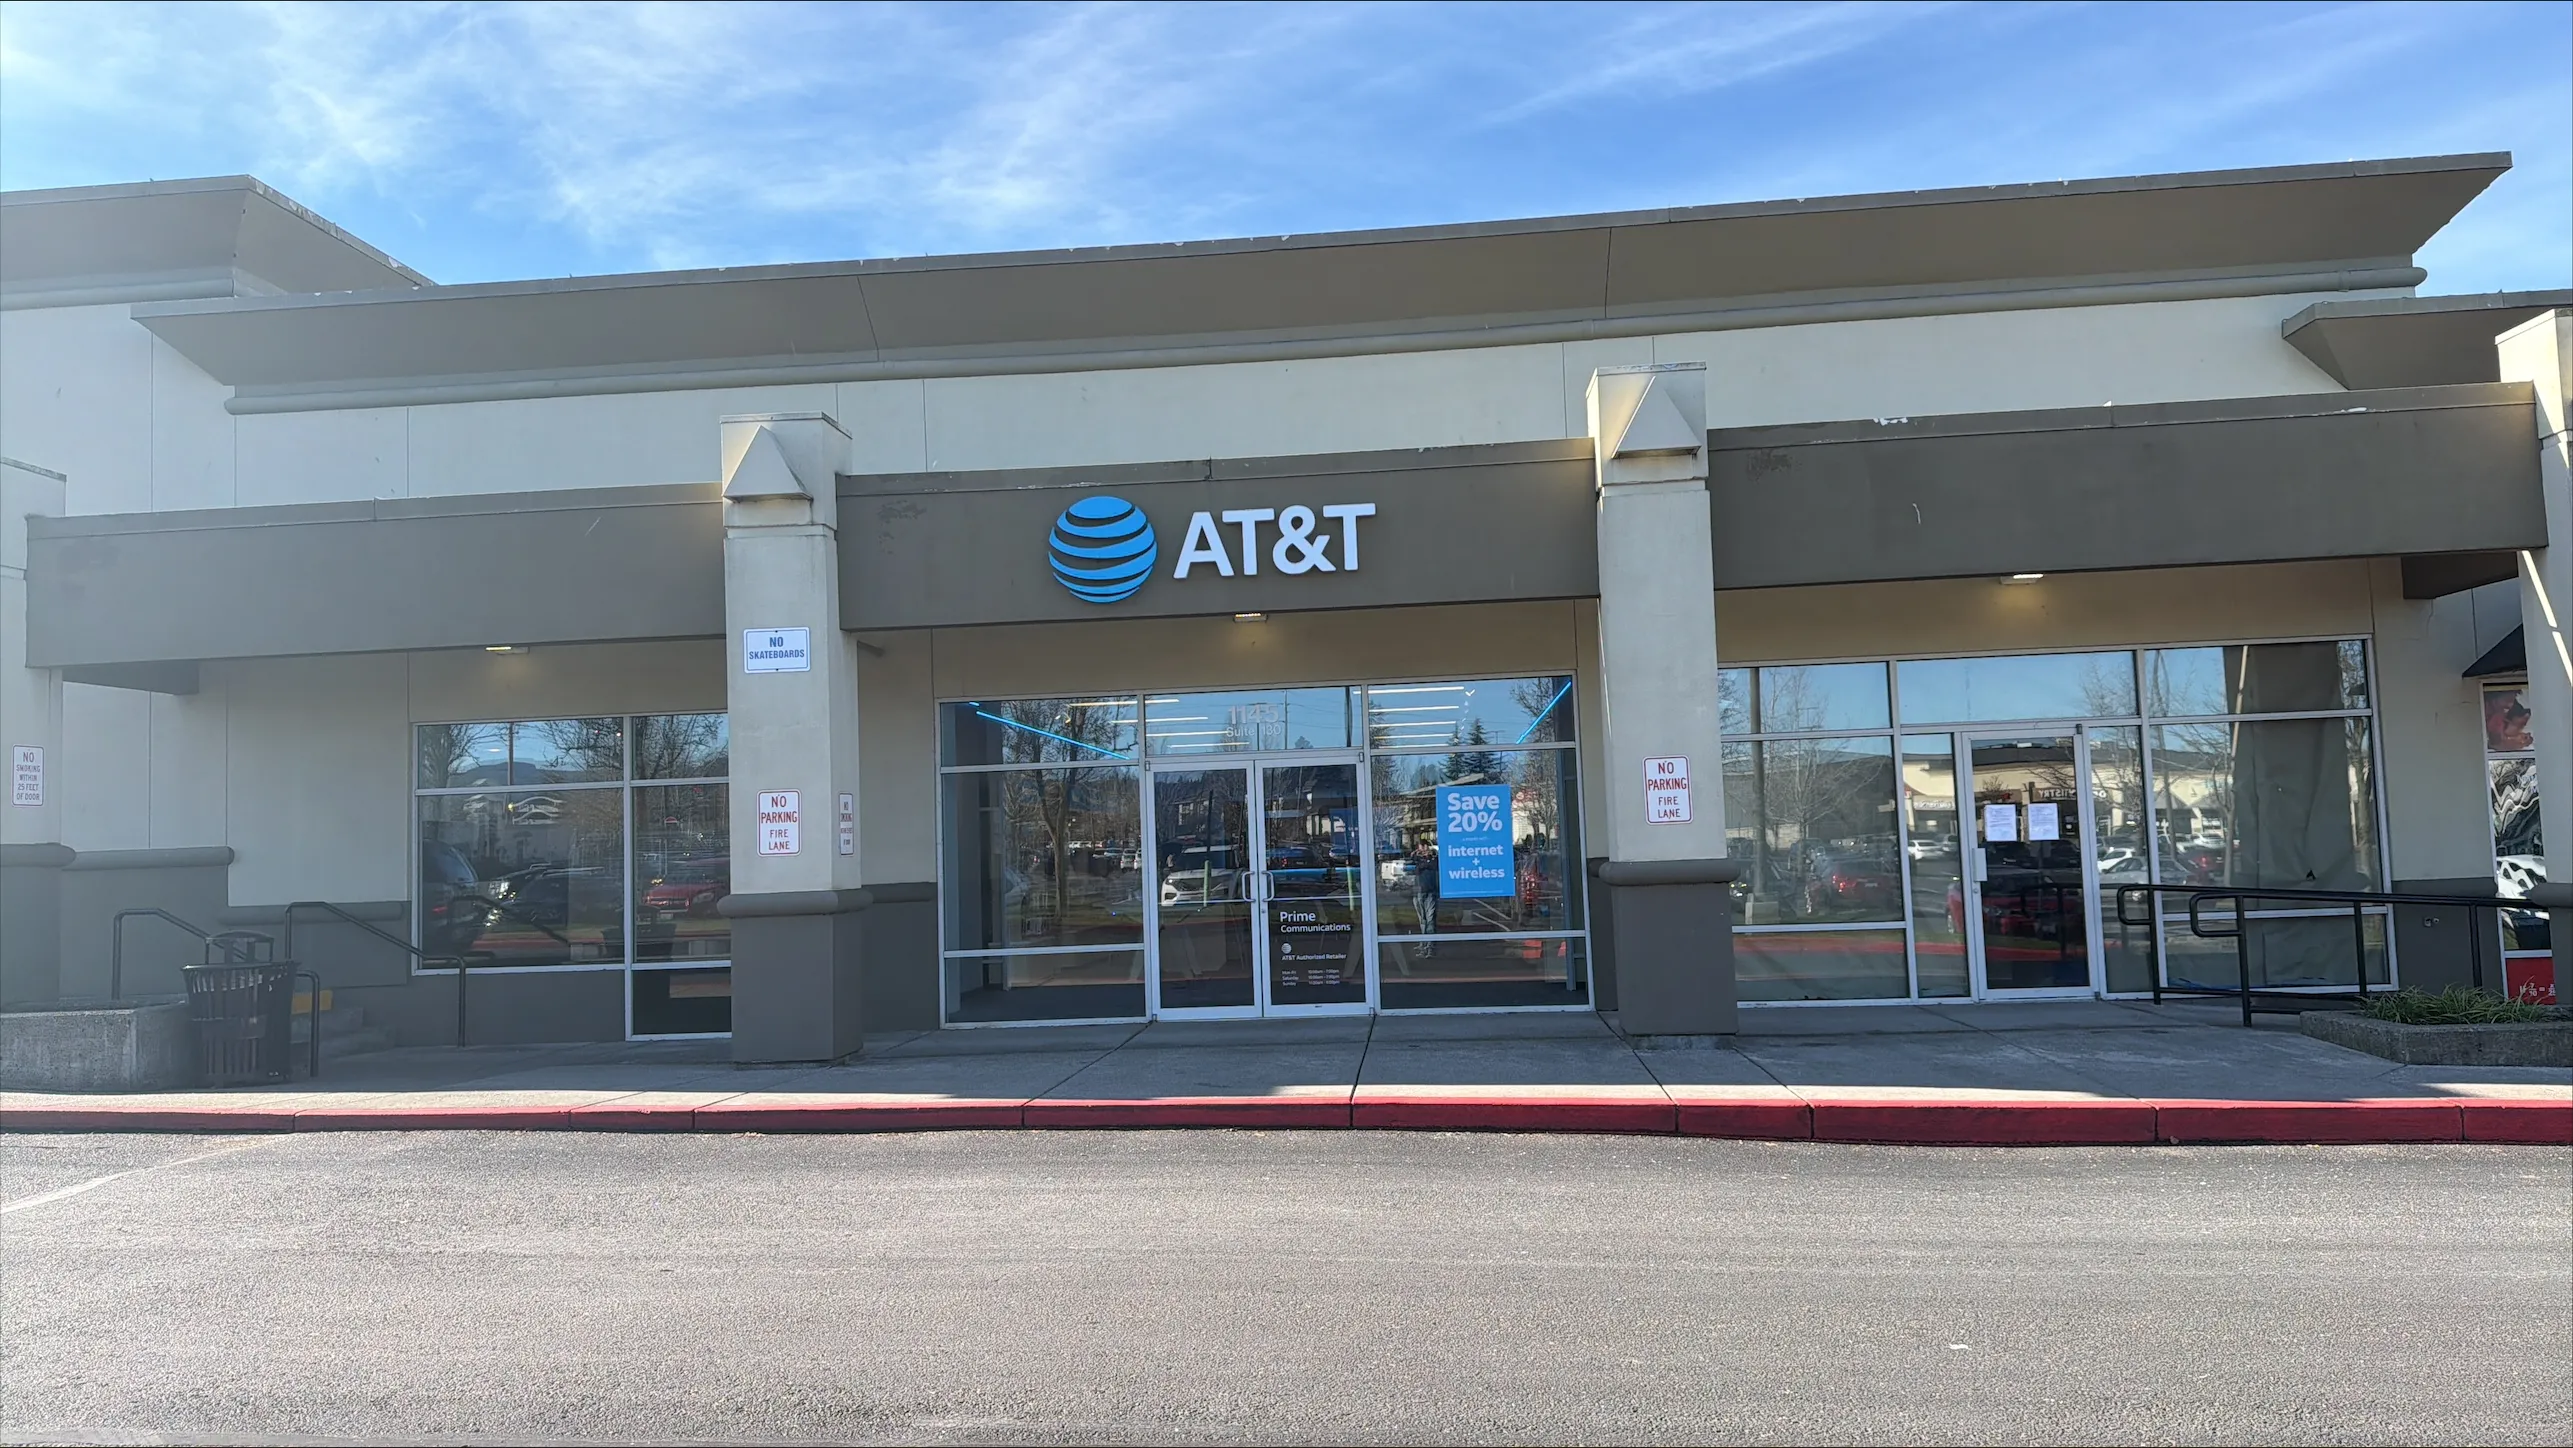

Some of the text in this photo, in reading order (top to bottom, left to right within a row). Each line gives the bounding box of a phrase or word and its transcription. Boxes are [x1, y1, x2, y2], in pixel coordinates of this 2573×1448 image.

[1173, 503, 1377, 579] AT&T
[769, 636, 784, 648] NO
[748, 649, 805, 660] SKATEBOARDS
[1226, 726, 1255, 738] Suite
[23, 752, 35, 763] NO
[16, 764, 40, 773] SMOKING
[1658, 762, 1674, 775] NO
[17, 783, 39, 791] 25 FEET
[1647, 777, 1687, 791] PARKING
[16, 792, 24, 801] OF
[771, 795, 787, 808] NO
[1447, 792, 1500, 811] Save
[1658, 796, 1678, 806] FIRE
[760, 811, 798, 824] PARKING
[1657, 808, 1681, 818] LANE
[1447, 811, 1503, 833] 20%
[769, 829, 788, 839] FIRE
[768, 841, 790, 851] LANE
[1448, 845, 1504, 857] internet
[1472, 858, 1480, 866] +
[1448, 866, 1505, 880] wireless
[1280, 911, 1316, 923] Prime
[1280, 923, 1351, 933] Communications
[1296, 953, 1325, 961] Authorized
